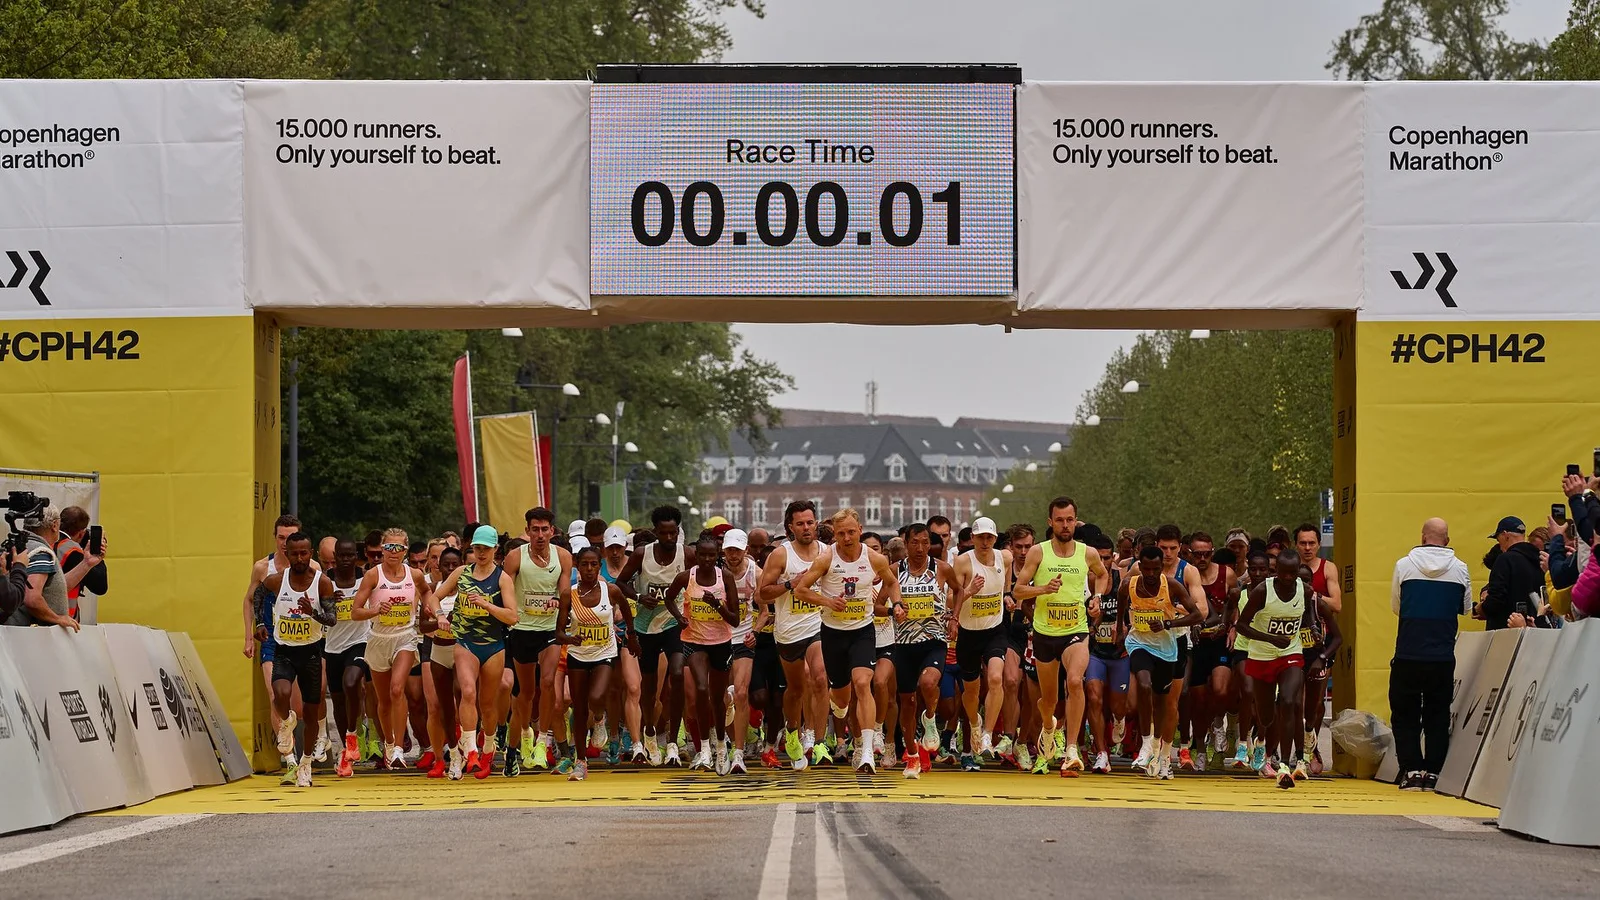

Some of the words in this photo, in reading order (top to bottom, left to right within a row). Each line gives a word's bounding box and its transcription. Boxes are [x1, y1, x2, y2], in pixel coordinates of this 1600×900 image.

[0, 123, 120, 148] openhagen
[276, 119, 348, 139] 15.000
[354, 123, 442, 139] runners.
[1053, 119, 1125, 139] 15.000
[1131, 123, 1219, 139] runners.
[1389, 126, 1528, 150] Copenhagen
[276, 144, 326, 169] Only
[330, 144, 417, 169] yourself
[421, 145, 443, 165] to
[449, 144, 501, 165] beat.
[727, 139, 796, 164] Race
[805, 138, 875, 164] Time
[1053, 144, 1103, 169] Only
[1107, 143, 1194, 169] yourself
[1198, 145, 1220, 164] to
[1226, 144, 1278, 164] beat.
[631, 181, 961, 247] 00.00.01
[1391, 333, 1546, 364] #CPH42
[843, 605, 866, 613] ONSEN
[1048, 608, 1079, 621] NIJHUIS
[280, 621, 311, 635] OMAR
[579, 627, 610, 642] HAILU
[1268, 620, 1300, 635] PACE
